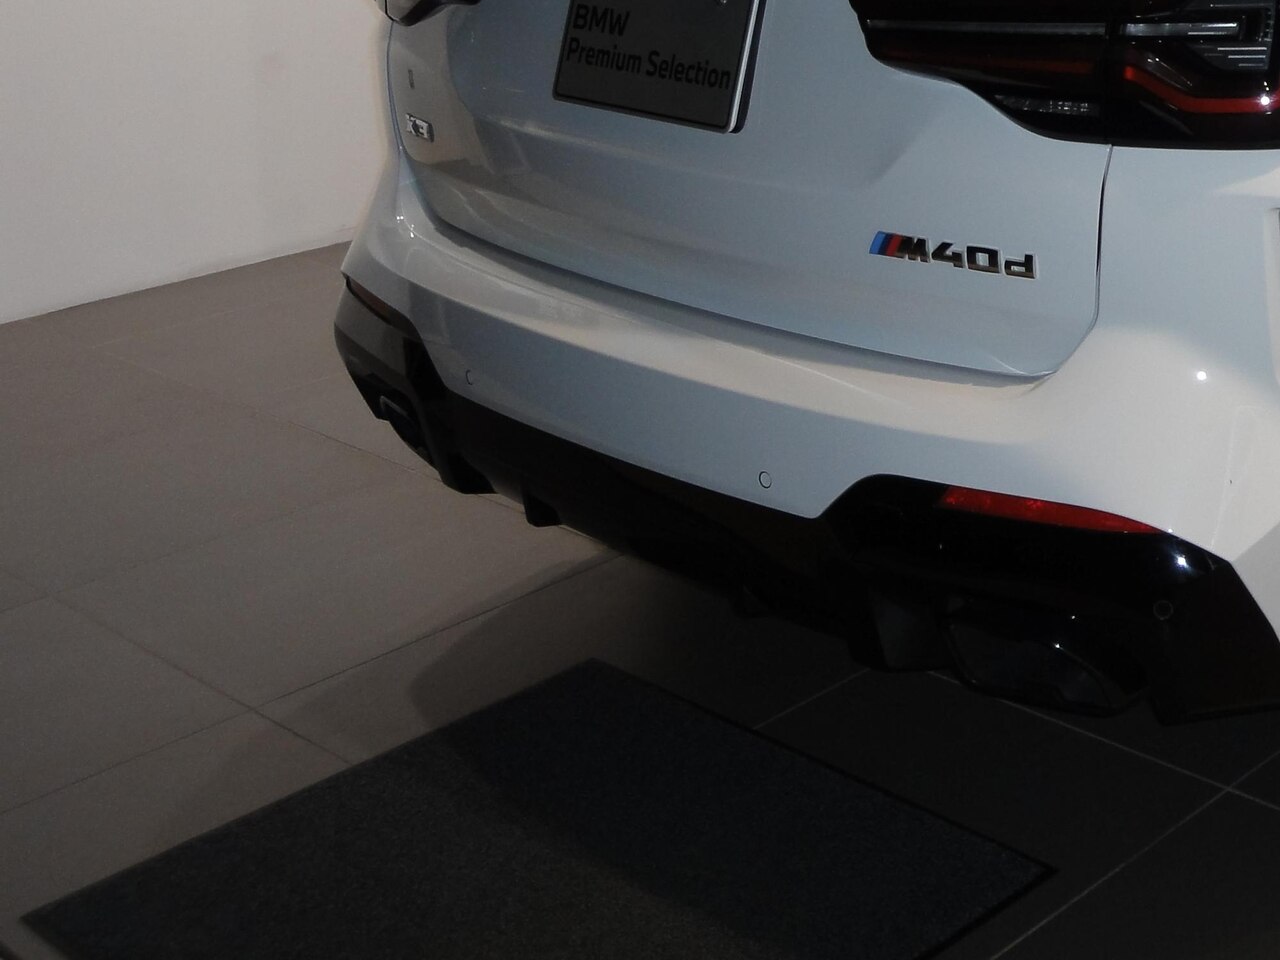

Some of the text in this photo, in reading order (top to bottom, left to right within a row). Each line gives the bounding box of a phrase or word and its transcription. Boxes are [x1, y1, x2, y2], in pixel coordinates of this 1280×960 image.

[572, 3, 631, 37] BMW
[566, 37, 732, 90] Premium Selection
[892, 232, 1037, 280] M40d
